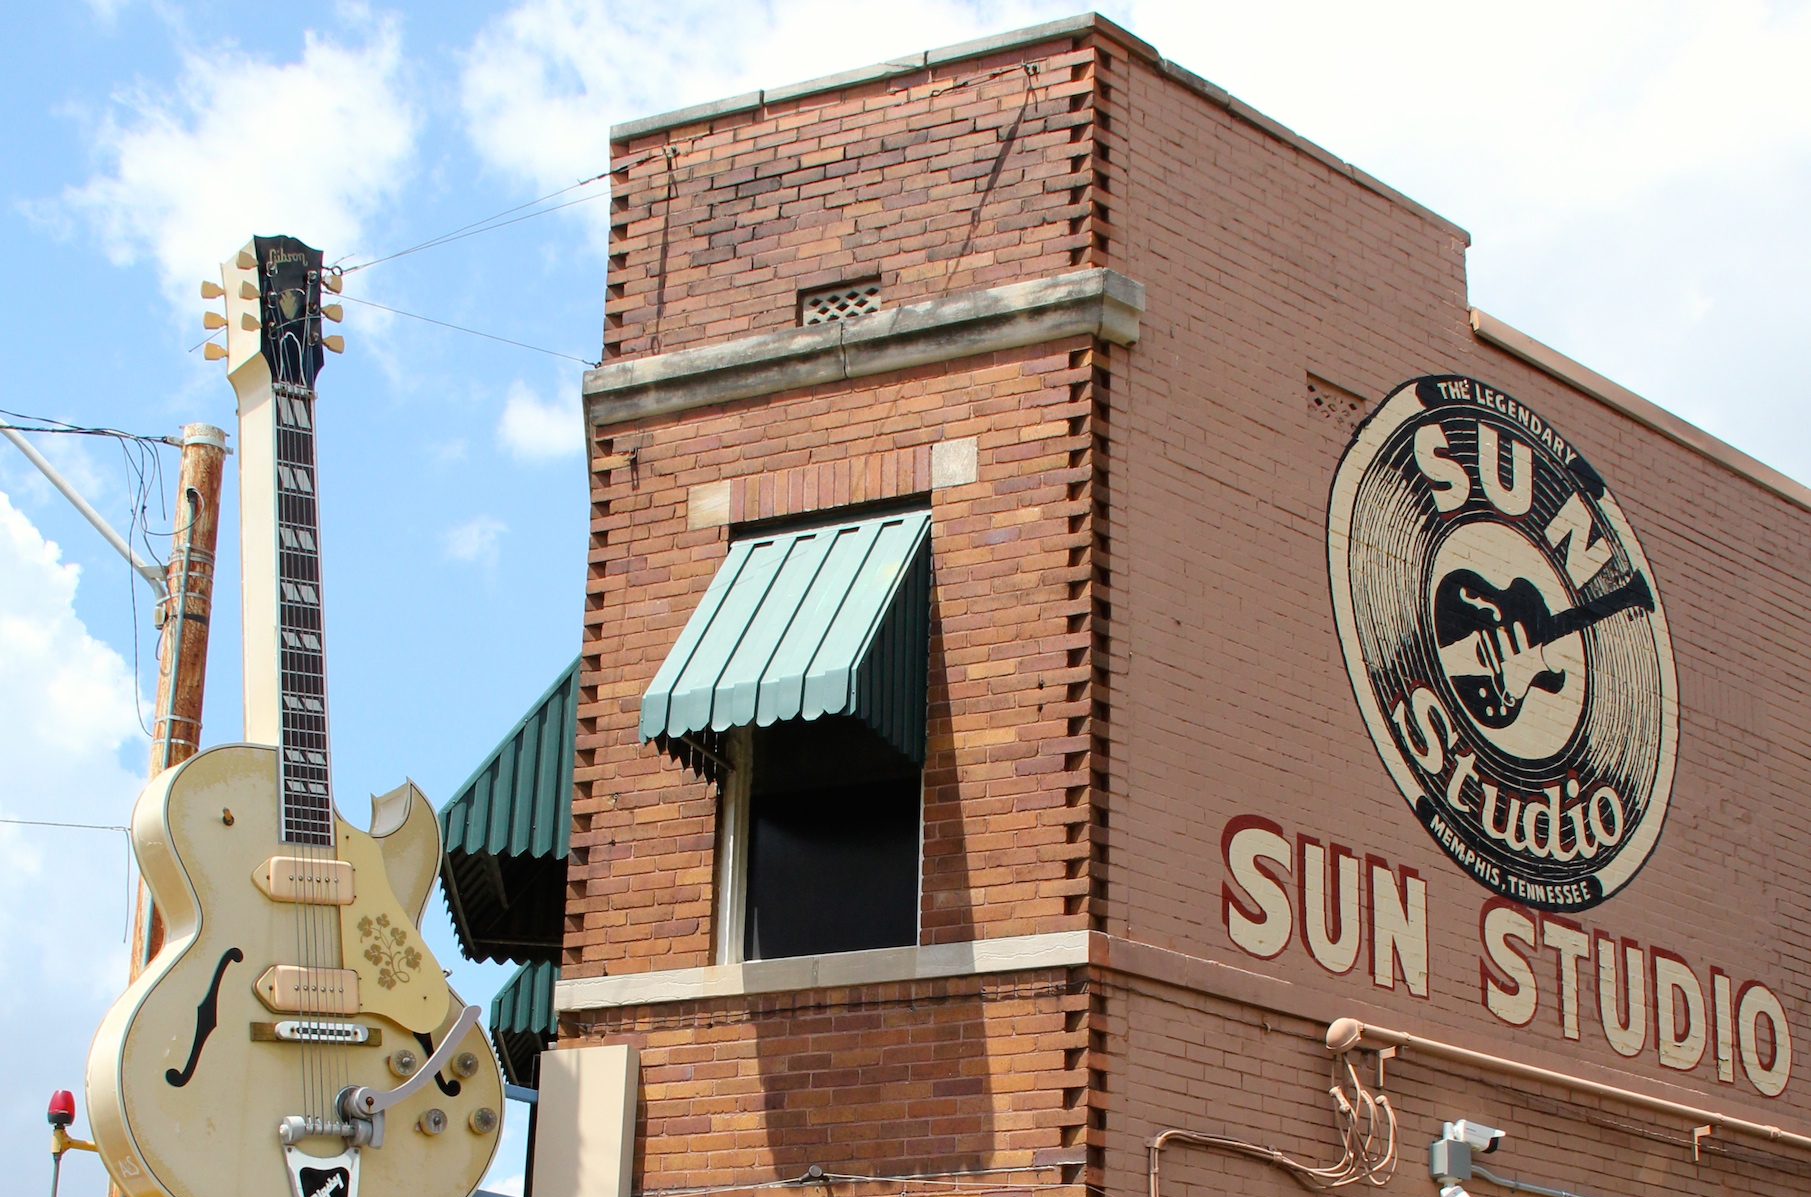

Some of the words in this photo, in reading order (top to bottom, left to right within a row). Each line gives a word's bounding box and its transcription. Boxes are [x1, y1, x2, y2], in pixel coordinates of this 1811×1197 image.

[267, 248, 308, 267] Gibson
[1437, 381, 1471, 400] THE
[1475, 383, 1577, 465] LEGENDARY
[1413, 421, 1614, 591] SUN
[1393, 686, 1625, 863] Studio
[1508, 875, 1590, 905] TENNESSEE
[1222, 815, 1429, 998] SUN
[1480, 898, 1792, 1097] STUDIO
